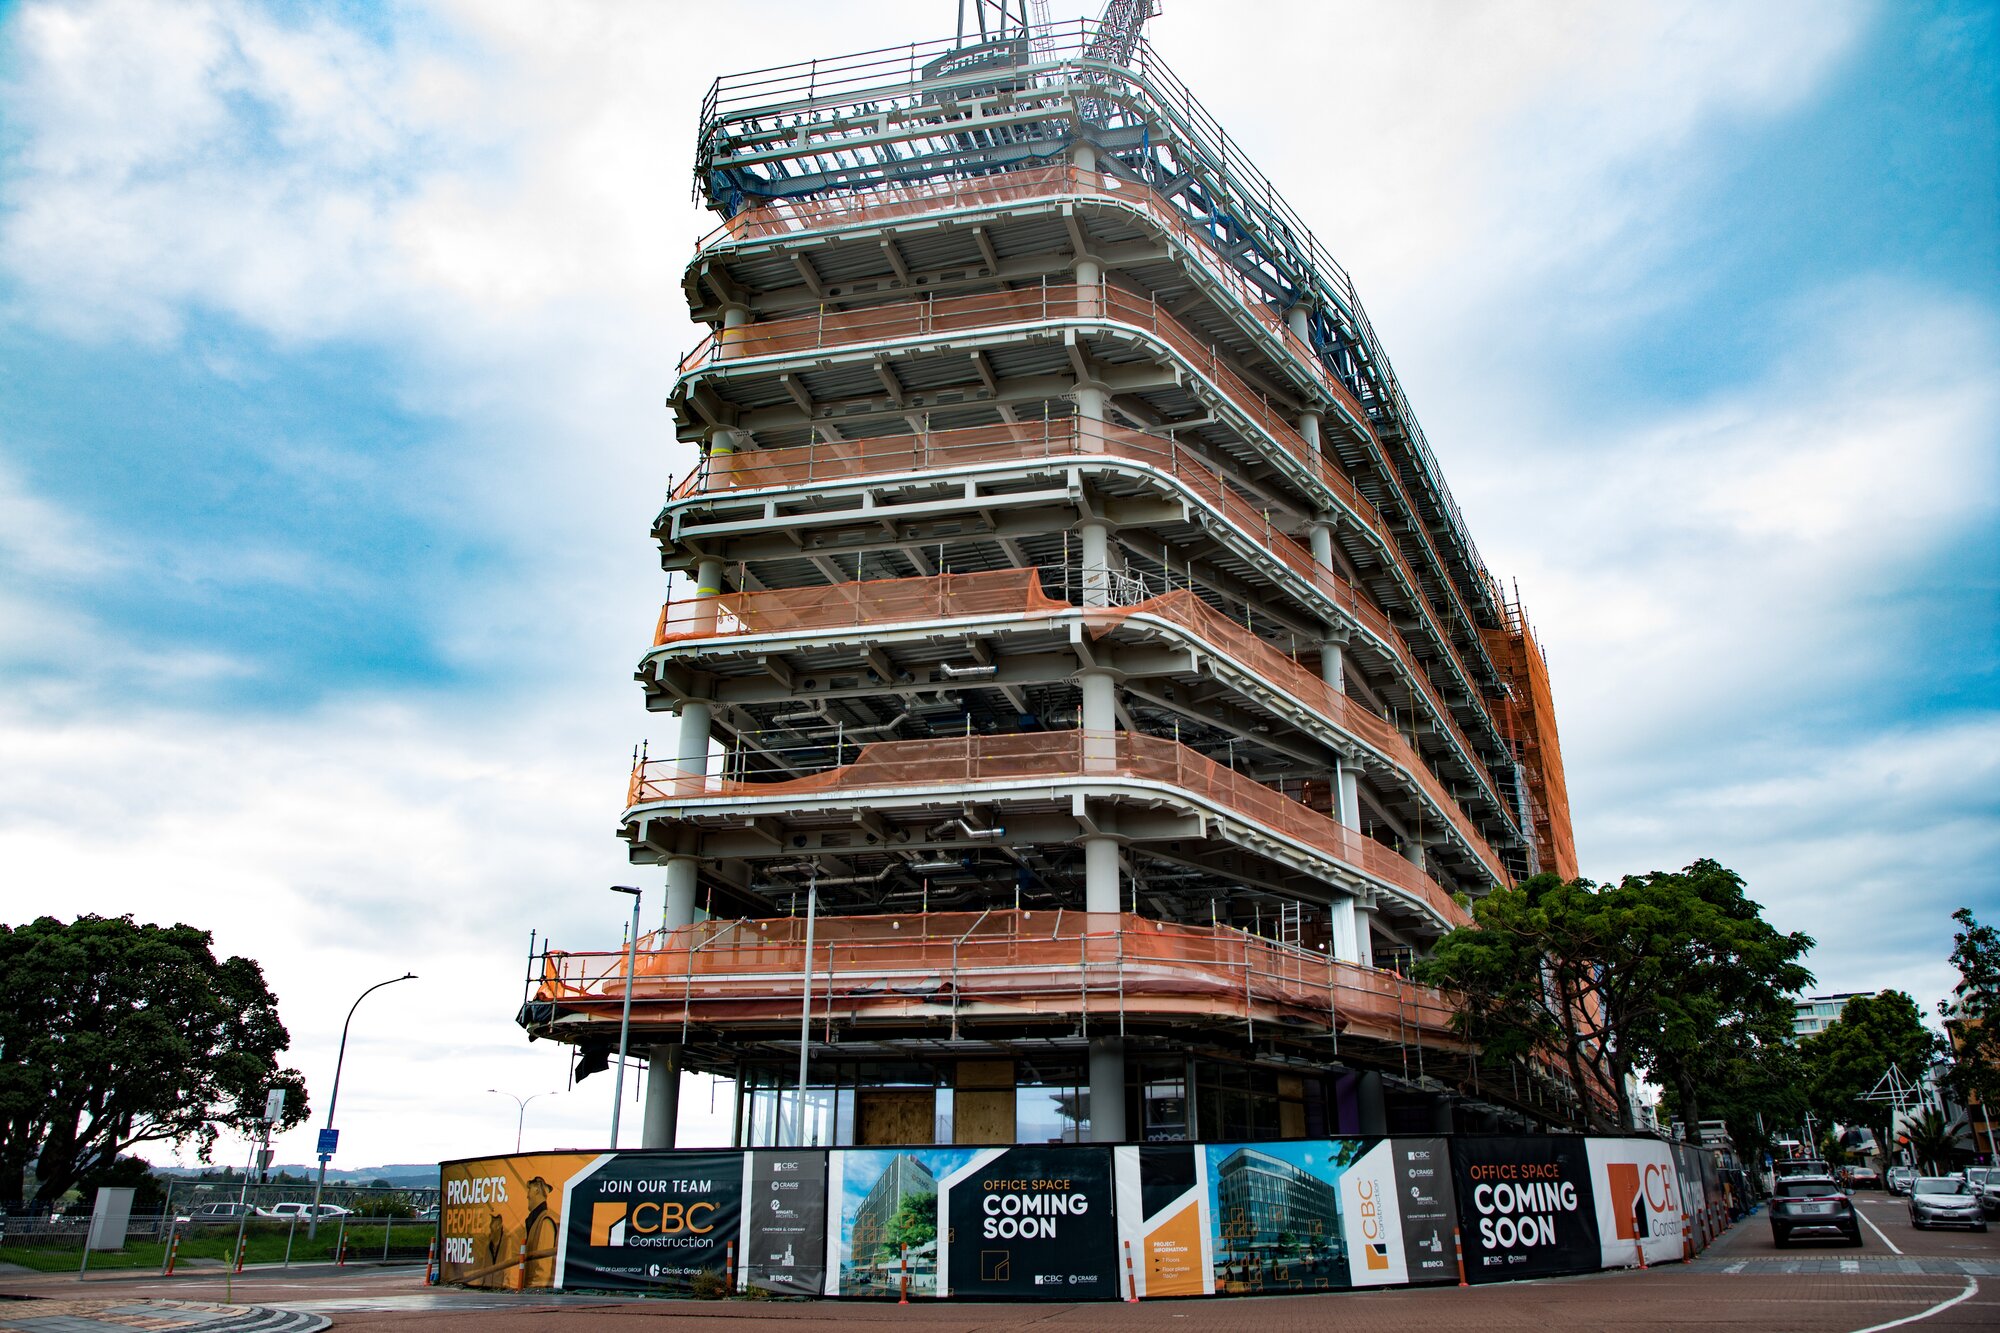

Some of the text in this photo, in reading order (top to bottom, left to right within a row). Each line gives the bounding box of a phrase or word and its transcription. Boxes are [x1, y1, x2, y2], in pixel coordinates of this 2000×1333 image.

[1470, 1164, 1560, 1180] OFFICE SPACE
[447, 1176, 508, 1205] PROJECTS.
[600, 1180, 712, 1193] JOIN OUR TEAM
[983, 1179, 1071, 1191] OFFICE SPACE
[983, 1193, 1089, 1216] COMING
[1474, 1181, 1578, 1215] COMING
[632, 1202, 715, 1234] CBC
[1358, 1180, 1378, 1240] CBC
[1374, 1179, 1386, 1240] Construction
[983, 1217, 1056, 1239] SOON
[1480, 1215, 1556, 1249] SOON
[445, 1237, 474, 1264] PRIDE.
[629, 1235, 714, 1248] Construction
[1490, 1255, 1503, 1263] CBC
[661, 1267, 702, 1276] Classic Group
[1043, 1274, 1063, 1282] CBC
